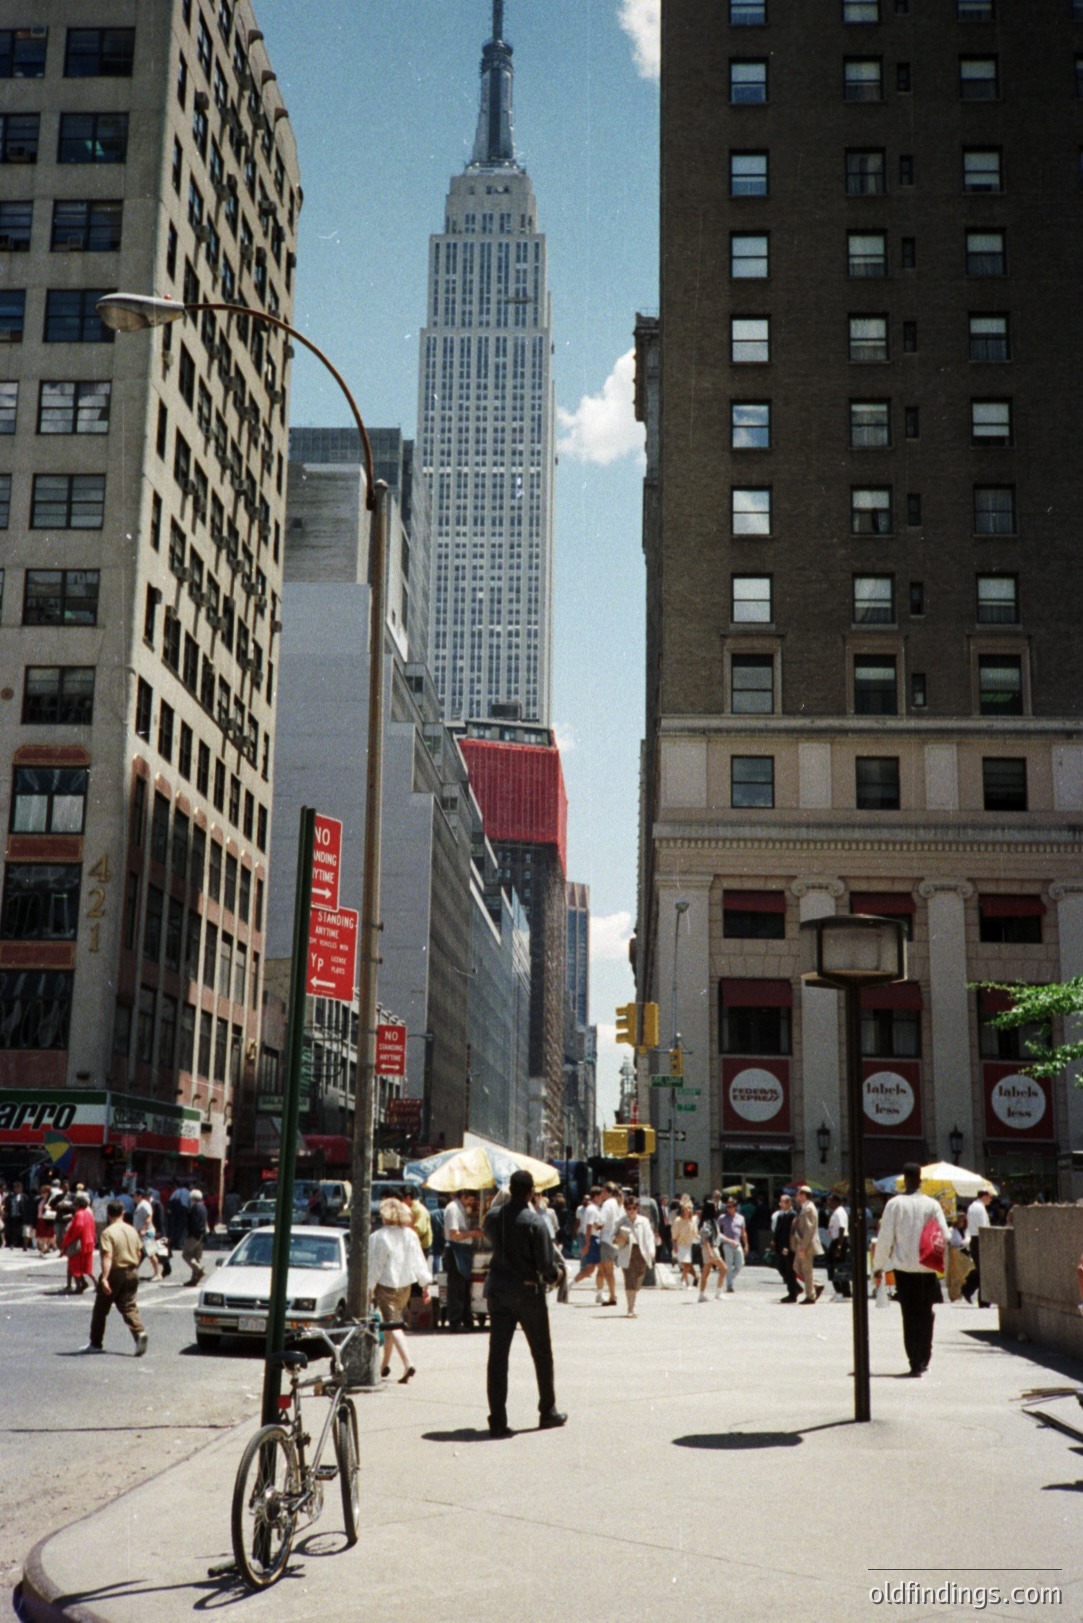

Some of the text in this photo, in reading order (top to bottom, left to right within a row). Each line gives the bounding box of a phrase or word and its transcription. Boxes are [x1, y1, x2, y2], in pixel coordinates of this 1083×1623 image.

[314, 825, 331, 846] NO
[313, 849, 337, 867] NDING
[312, 867, 335, 885] YTIME
[87, 853, 111, 952] 421
[317, 911, 354, 929] STANDING
[315, 925, 339, 939] ANYTIME
[384, 1030, 399, 1042] NO
[378, 1043, 404, 1052] STANDING
[379, 1054, 402, 1062] ANYTIME
[732, 1087, 779, 1095] FEDERAL
[866, 1082, 907, 1095] labels
[998, 1085, 1038, 1098] labels
[875, 1103, 900, 1115] less
[1007, 1106, 1032, 1118] less
